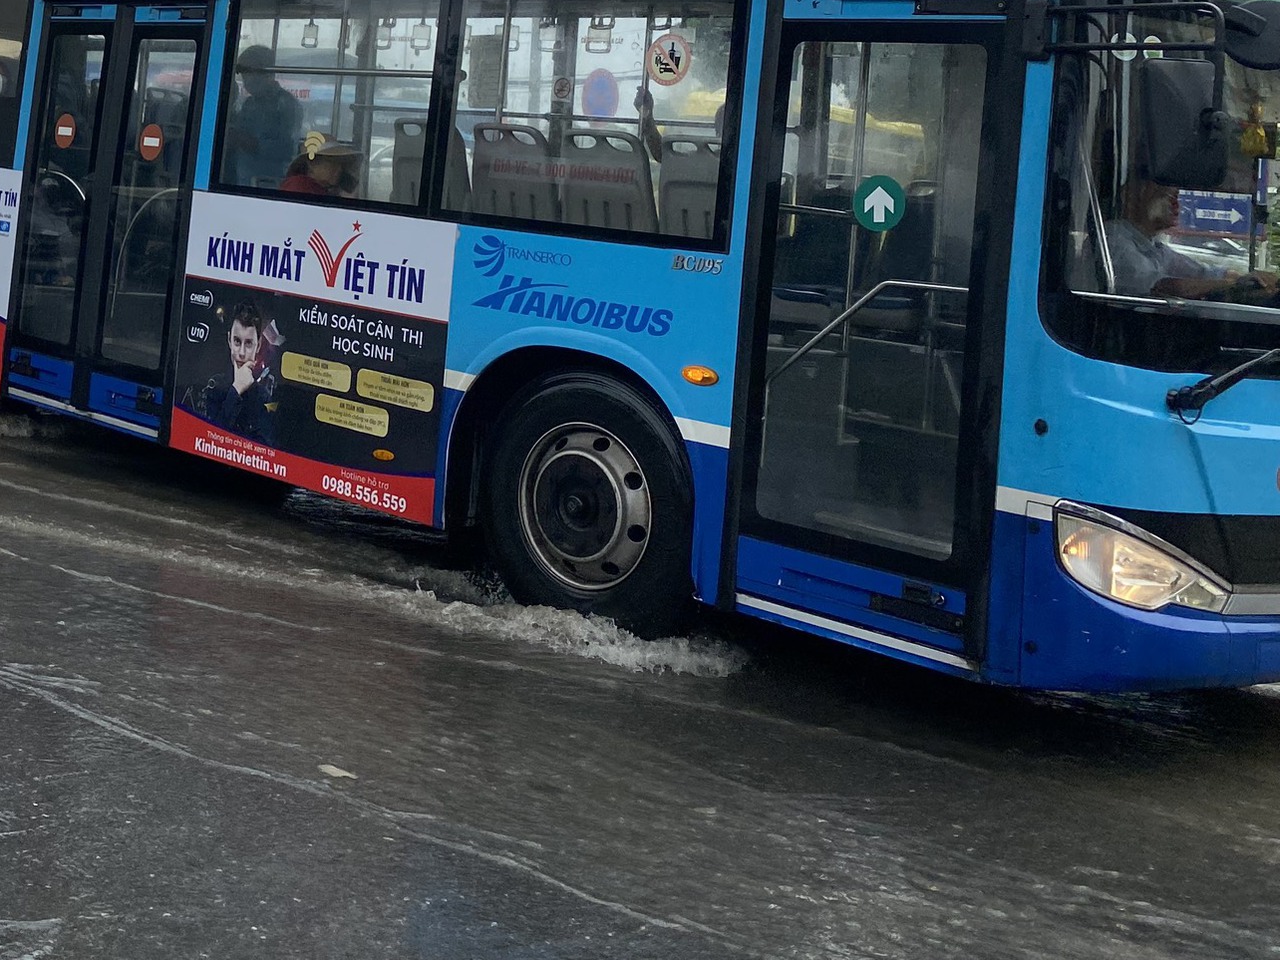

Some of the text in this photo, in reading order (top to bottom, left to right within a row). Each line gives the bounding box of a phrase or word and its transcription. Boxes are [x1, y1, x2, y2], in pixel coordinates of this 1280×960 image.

[4, 188, 17, 207] TÍN
[207, 232, 254, 274] KÍNH
[259, 238, 306, 282] MẮT
[386, 258, 426, 304] TÍN
[507, 246, 572, 267] TRANSERCO
[672, 254, 723, 275] BC095
[190, 293, 210, 304] CHEMI
[471, 274, 674, 337] HANOIBUS
[190, 326, 205, 339] U10
[299, 305, 424, 349] KIỂM SOÁT CẬN THỊ
[332, 335, 395, 363] HỌC SINH
[207, 430, 224, 444] Thông
[224, 435, 233, 445] tin
[244, 440, 254, 451] tiết
[254, 445, 267, 454] xem
[194, 436, 287, 477] Kinhmatviettin.vn
[341, 469, 366, 483] Hotline
[322, 475, 406, 514] 0988.556.559
